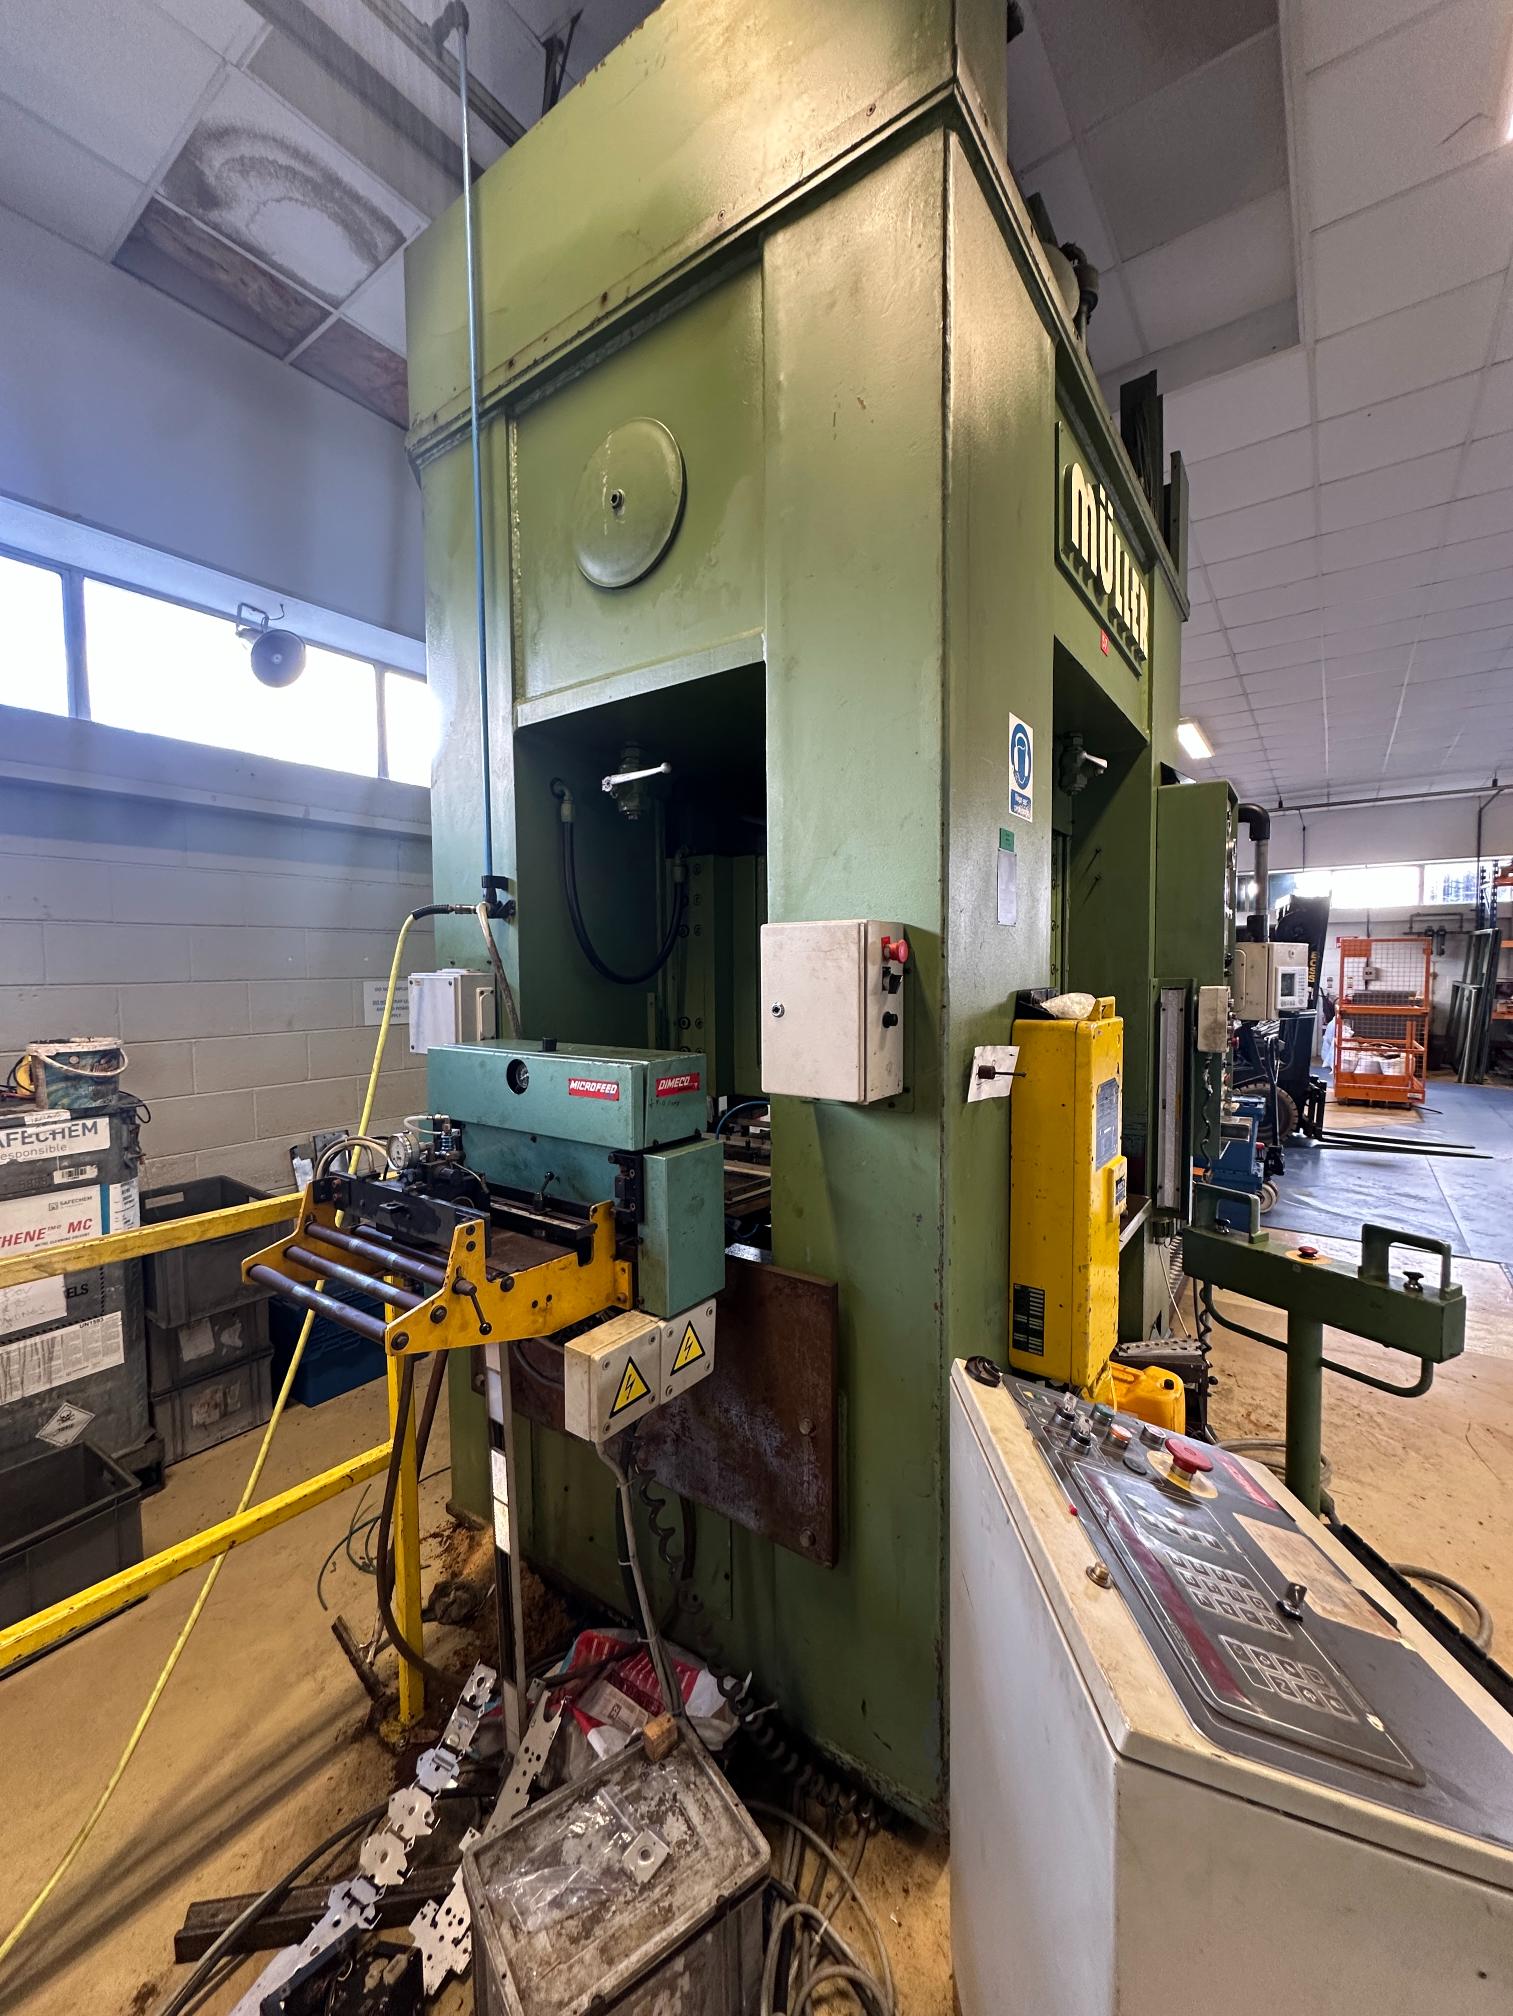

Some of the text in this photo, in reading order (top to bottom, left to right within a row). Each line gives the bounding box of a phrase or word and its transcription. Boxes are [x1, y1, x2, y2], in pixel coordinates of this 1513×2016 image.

[570, 1080, 617, 1094] MICROFEED
[658, 1076, 690, 1091] DIMECO
[0, 1218, 92, 1248] HENE MC
